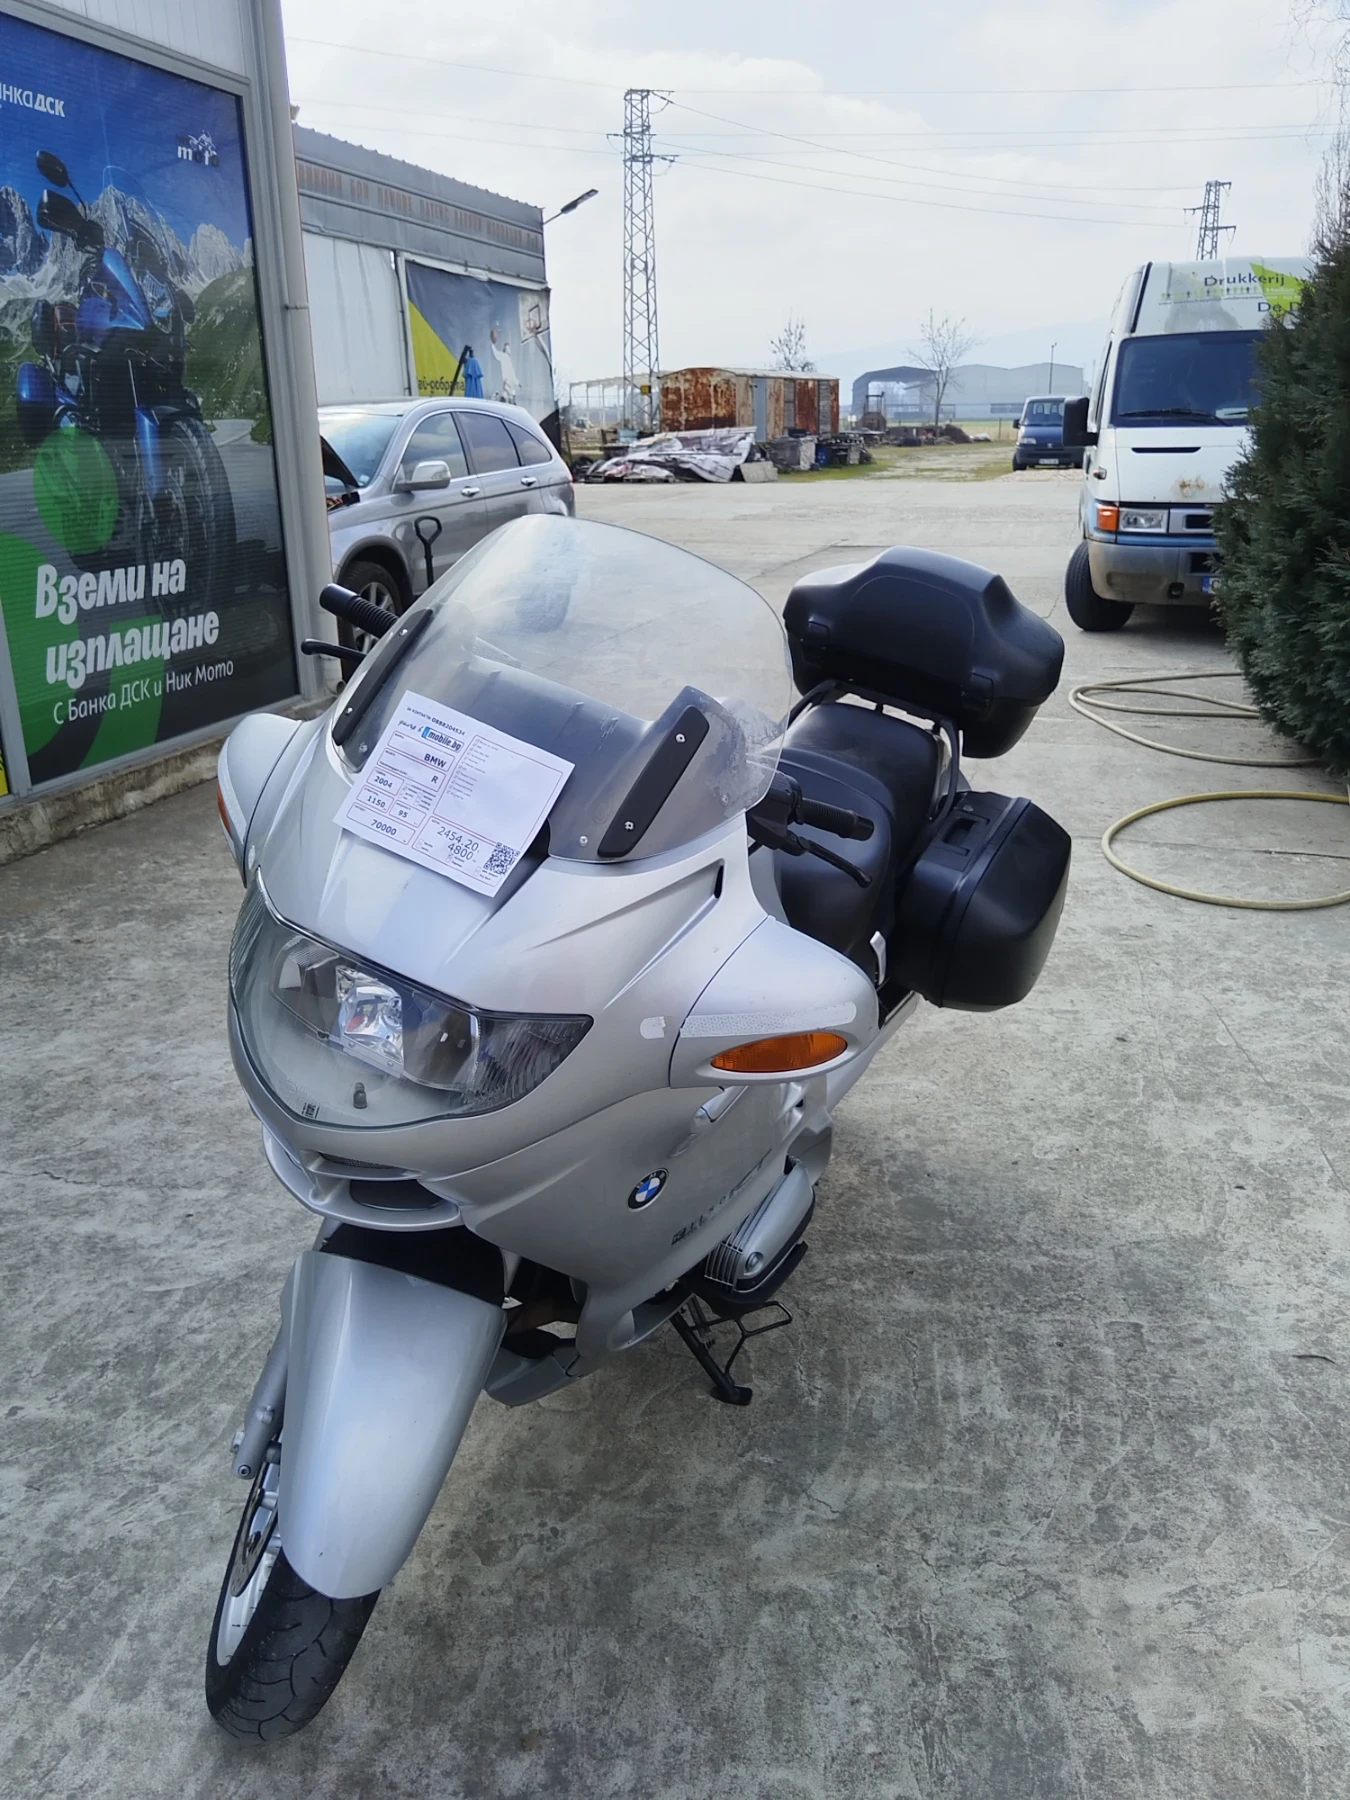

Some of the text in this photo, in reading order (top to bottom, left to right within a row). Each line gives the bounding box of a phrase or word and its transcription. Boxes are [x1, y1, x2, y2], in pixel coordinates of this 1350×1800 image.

[1204, 273, 1285, 287] Drukkerij
[1258, 302, 1282, 312] De
[36, 559, 186, 624] Вземи на
[46, 611, 219, 689] изплащане
[68, 692, 116, 721] Банка
[120, 678, 150, 710] ДСК
[153, 680, 162, 696] и
[166, 671, 192, 693] Ник
[195, 660, 234, 685] Мото
[428, 731, 461, 751] mobile.bg
[424, 753, 447, 768] BMW
[374, 775, 393, 788] 2004
[430, 775, 439, 784] R
[367, 796, 386, 808] 1150
[398, 809, 408, 818] 95
[370, 819, 397, 836] 70000
[437, 826, 479, 852] 2454.20
[447, 843, 474, 860] 4800
